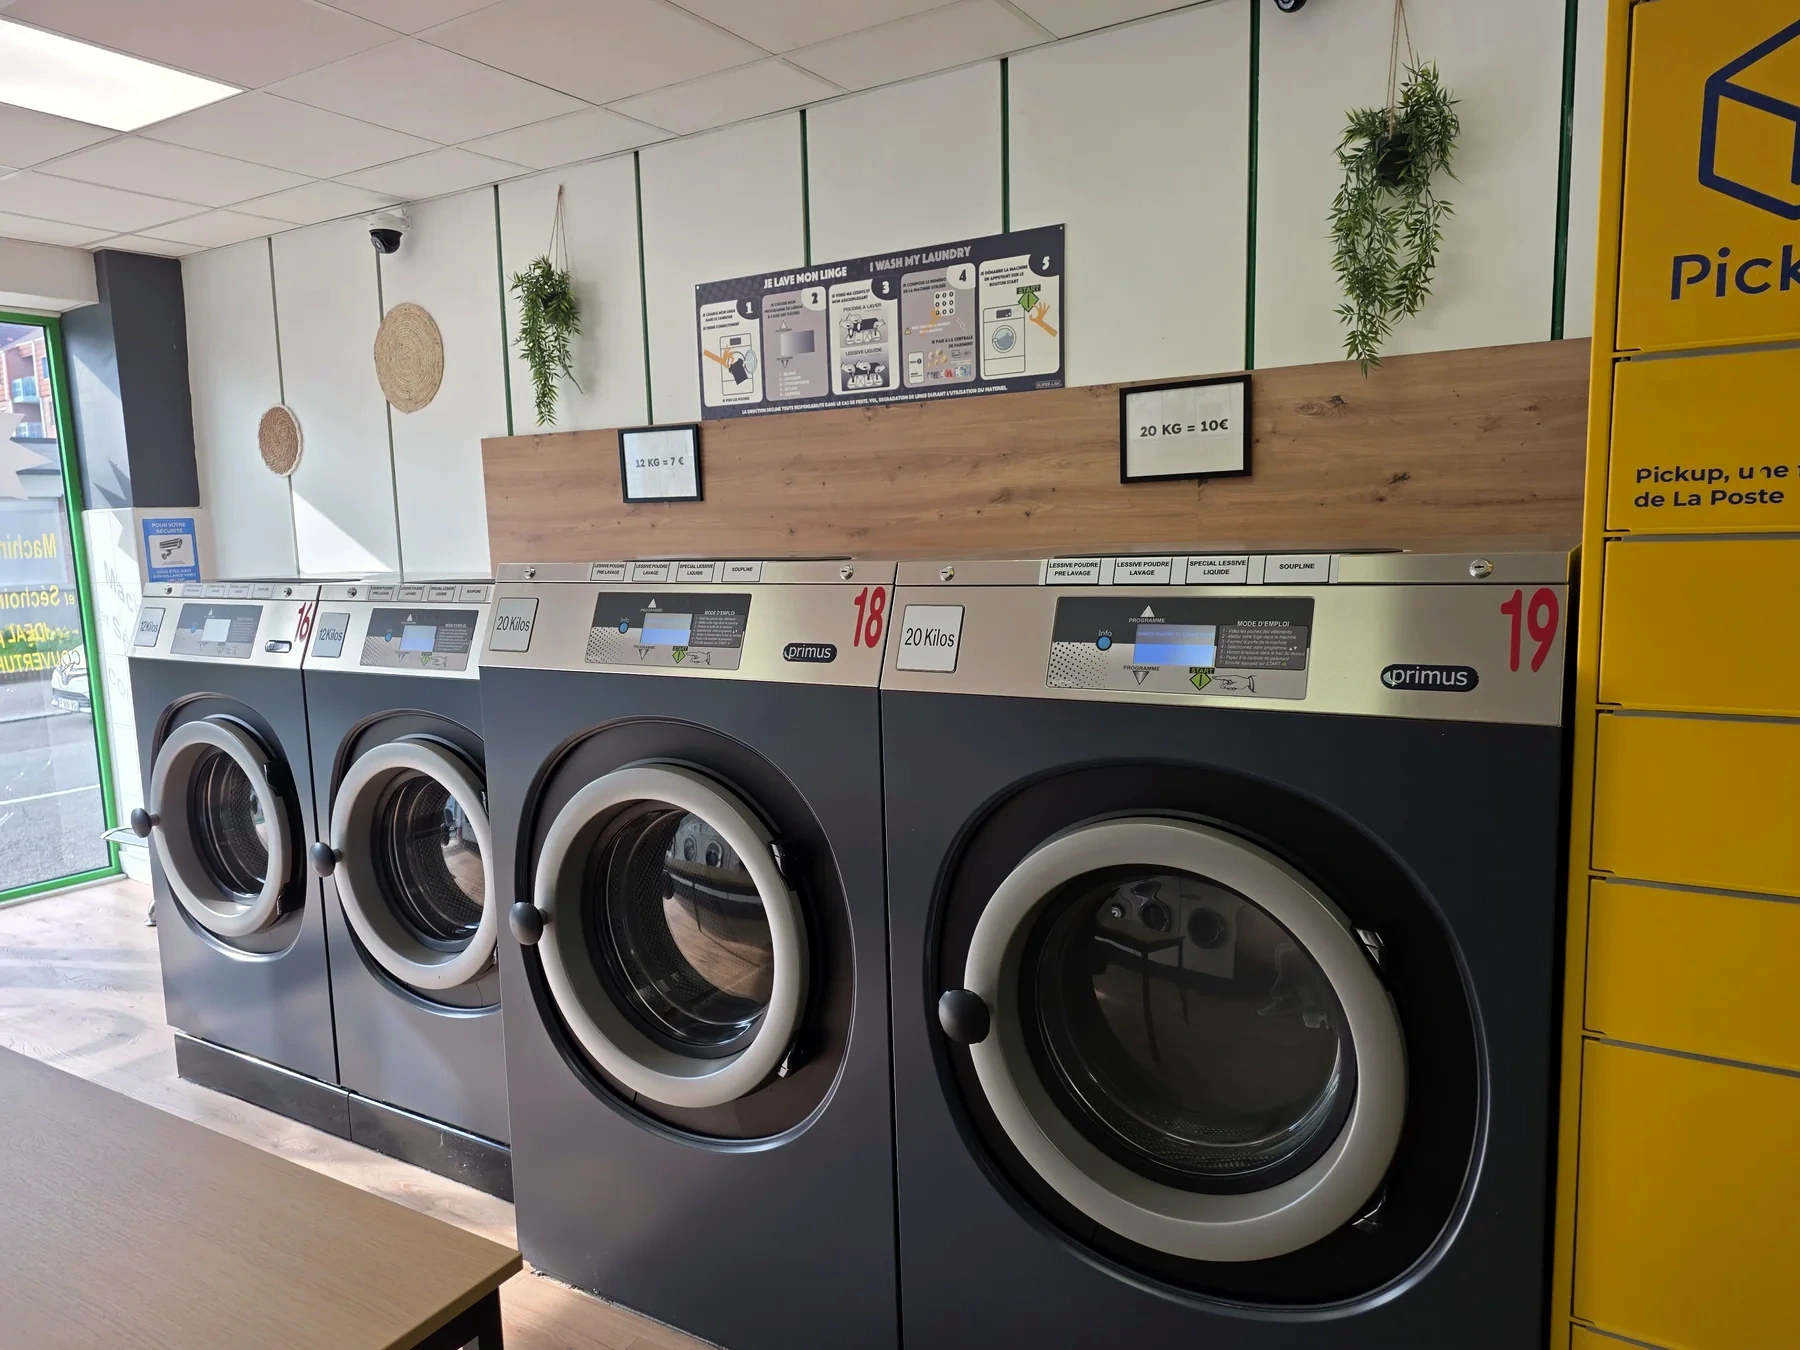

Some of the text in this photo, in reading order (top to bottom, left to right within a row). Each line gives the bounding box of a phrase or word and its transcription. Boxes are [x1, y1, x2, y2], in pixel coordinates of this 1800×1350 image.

[870, 246, 971, 272] I WASH MY LAUNDRY
[1043, 256, 1049, 270] 5
[764, 267, 847, 289] JE LAVE MON LINGE
[959, 270, 966, 281] 4
[882, 281, 889, 294] 3
[1018, 285, 1040, 294] START
[812, 293, 818, 304] 2
[746, 302, 753, 314] 1
[1140, 426, 1156, 437] 20
[1162, 423, 1182, 435] KG
[1201, 419, 1228, 432] 10€
[636, 459, 645, 468] 12
[648, 458, 660, 467] KG
[671, 457, 675, 465] 7
[679, 457, 684, 465] €
[1637, 466, 1729, 484] Pickup,
[1634, 489, 1784, 507] de La Poste
[295, 602, 312, 642] 16
[497, 616, 530, 632] 20 Kilos
[854, 586, 886, 648] 18
[904, 628, 955, 647] 20 Kilos
[1501, 588, 1559, 672] 19
[788, 644, 831, 660] primus
[1392, 666, 1468, 686] primus
